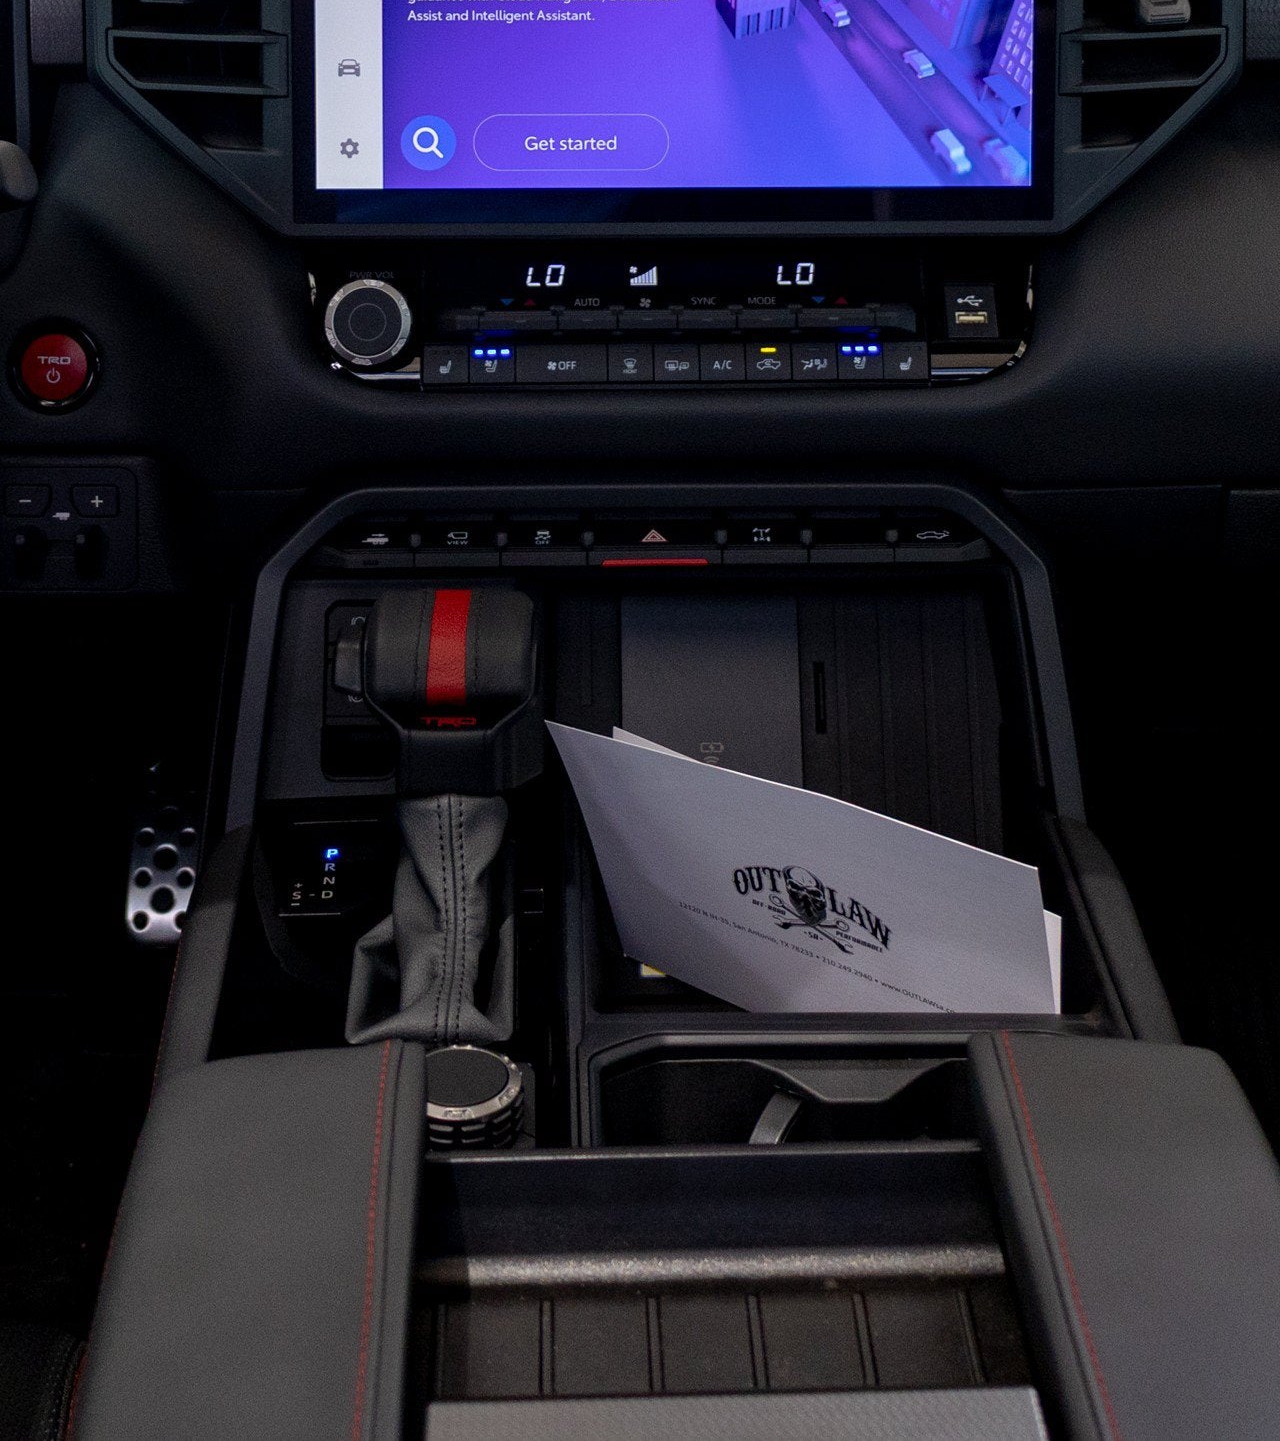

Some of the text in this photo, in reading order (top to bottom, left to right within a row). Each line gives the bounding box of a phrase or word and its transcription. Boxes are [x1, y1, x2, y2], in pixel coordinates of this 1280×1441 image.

[407, 9, 596, 24] Assist and Intelligent Assistant.
[524, 136, 618, 152] Get started
[349, 270, 395, 279] PWR VOL
[525, 263, 566, 287] LO
[776, 261, 816, 286] LO
[574, 297, 600, 308] AUTO
[690, 296, 717, 306] SYNC
[747, 296, 777, 306] MODE
[37, 355, 72, 366] TRD
[557, 359, 577, 371] OFF
[713, 359, 732, 371] A/C
[420, 716, 478, 728] TRD
[326, 847, 339, 859] P
[324, 862, 336, 872] R
[323, 876, 336, 885] N
[732, 864, 784, 897] OUT
[292, 891, 302, 900] S
[321, 890, 334, 899] D
[825, 886, 893, 950] LAW
[732, 921, 747, 933] San
[780, 939, 791, 949] TX
[792, 943, 815, 959] 78233
[821, 955, 874, 982] 210.249.2940
